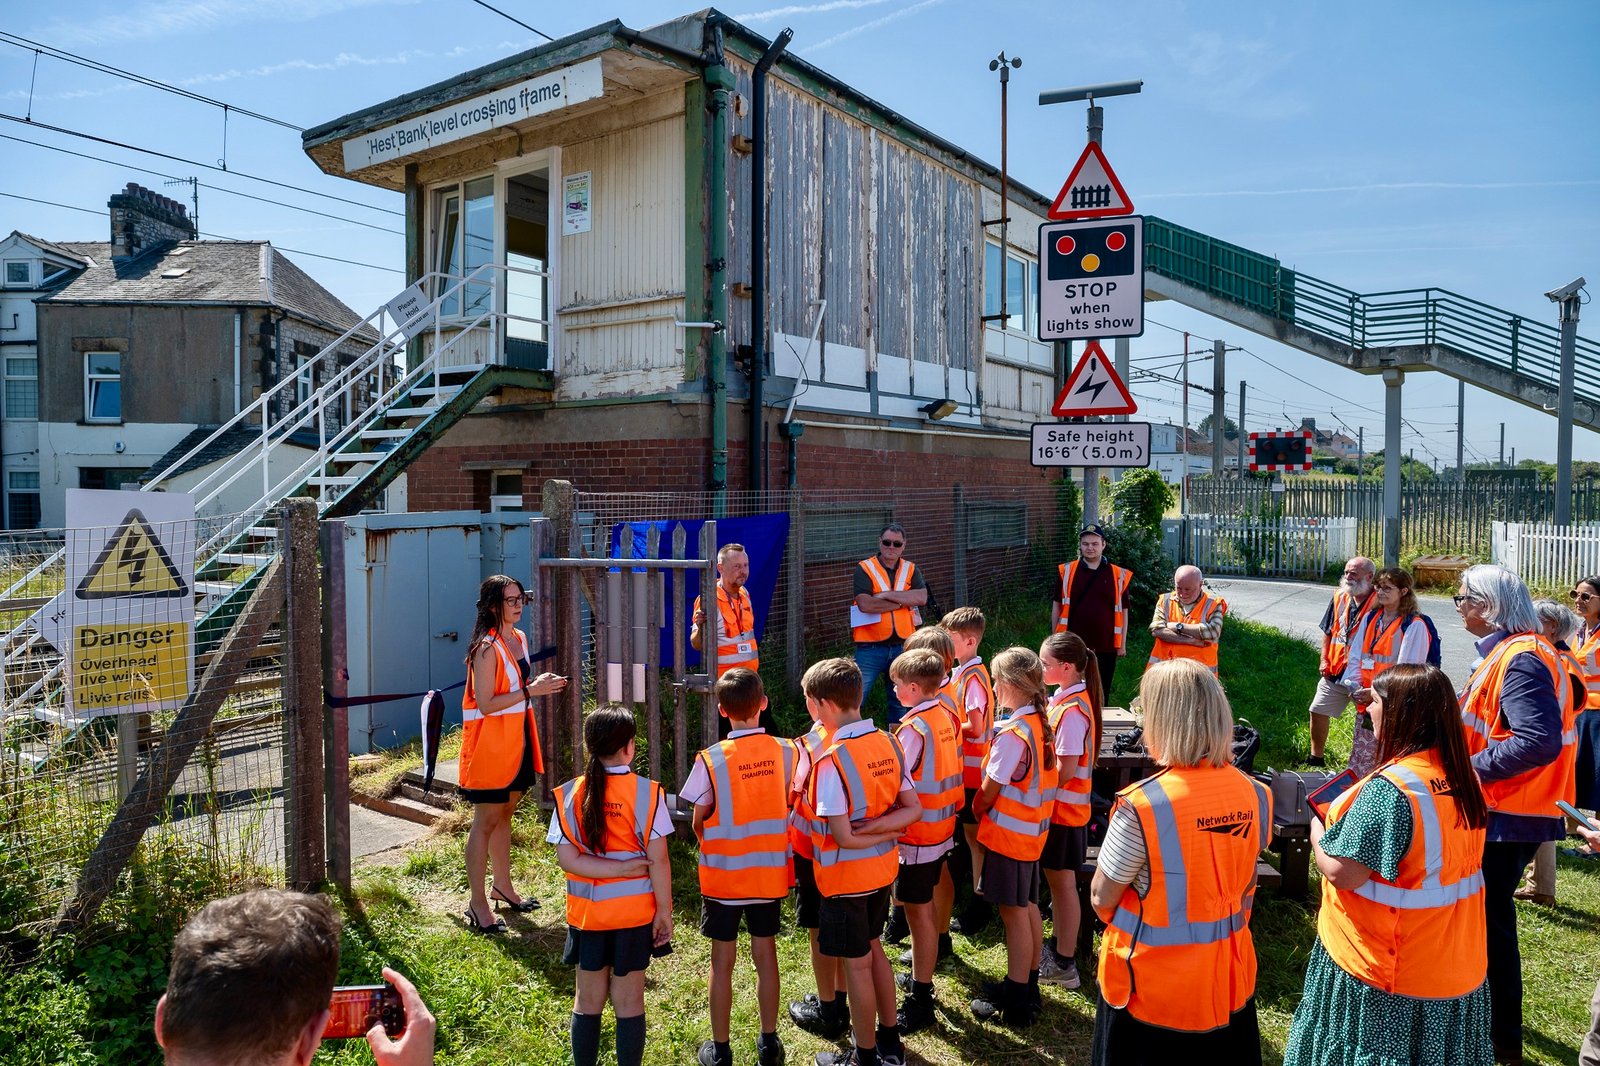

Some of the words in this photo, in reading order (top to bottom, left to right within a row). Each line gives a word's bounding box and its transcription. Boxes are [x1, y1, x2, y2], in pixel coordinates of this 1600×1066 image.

[370, 132, 396, 155] Hest
[399, 124, 428, 146] Bank
[429, 112, 459, 136] level
[461, 97, 516, 126] crossing
[519, 83, 561, 108] frame
[1065, 282, 1117, 299] STOP
[398, 297, 416, 312] Please
[406, 306, 419, 318] Hold
[1070, 302, 1110, 315] when
[1047, 319, 1089, 334] lights
[1094, 317, 1134, 329] show
[1047, 430, 1081, 442] Safe
[1086, 430, 1135, 445] height
[80, 628, 175, 649] Danger
[80, 655, 157, 671] Overhead
[80, 674, 107, 686] live
[112, 670, 153, 683] wires
[80, 692, 112, 705] Live
[117, 688, 150, 702] rails
[753, 760, 775, 769] SAFETY
[877, 758, 894, 767] SAFETY
[741, 769, 774, 780] CHAMPION
[1237, 810, 1254, 821] Rail
